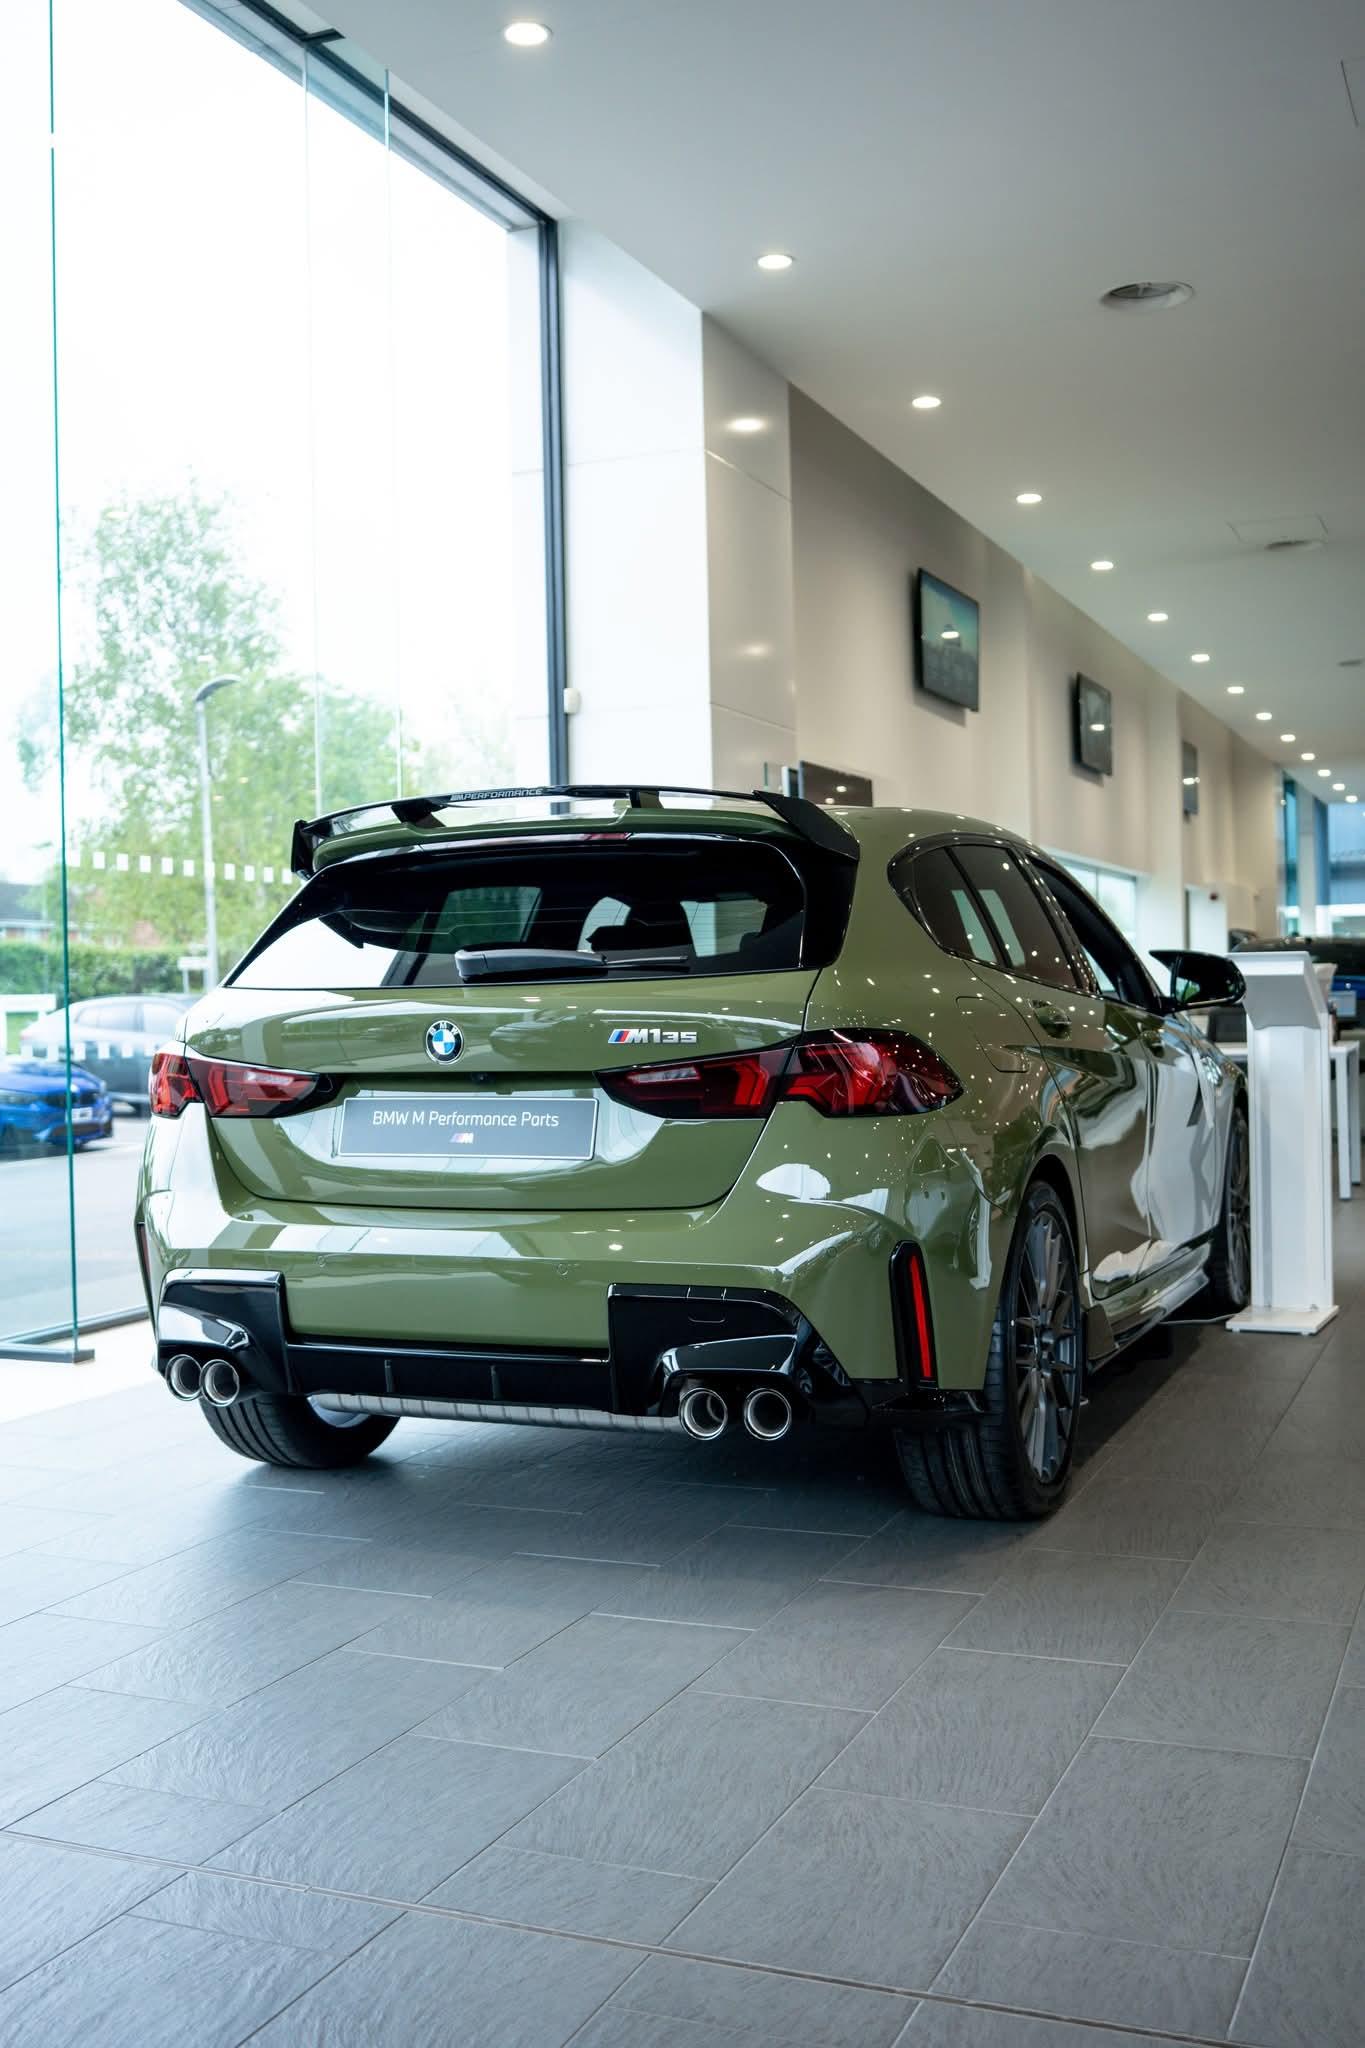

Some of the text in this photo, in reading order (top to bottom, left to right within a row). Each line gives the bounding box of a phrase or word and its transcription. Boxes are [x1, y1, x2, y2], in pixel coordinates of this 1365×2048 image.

[463, 788, 544, 800] PERFORMANCE
[622, 1028, 698, 1044] M135
[372, 1110, 560, 1127] BMW M Performance Parts
